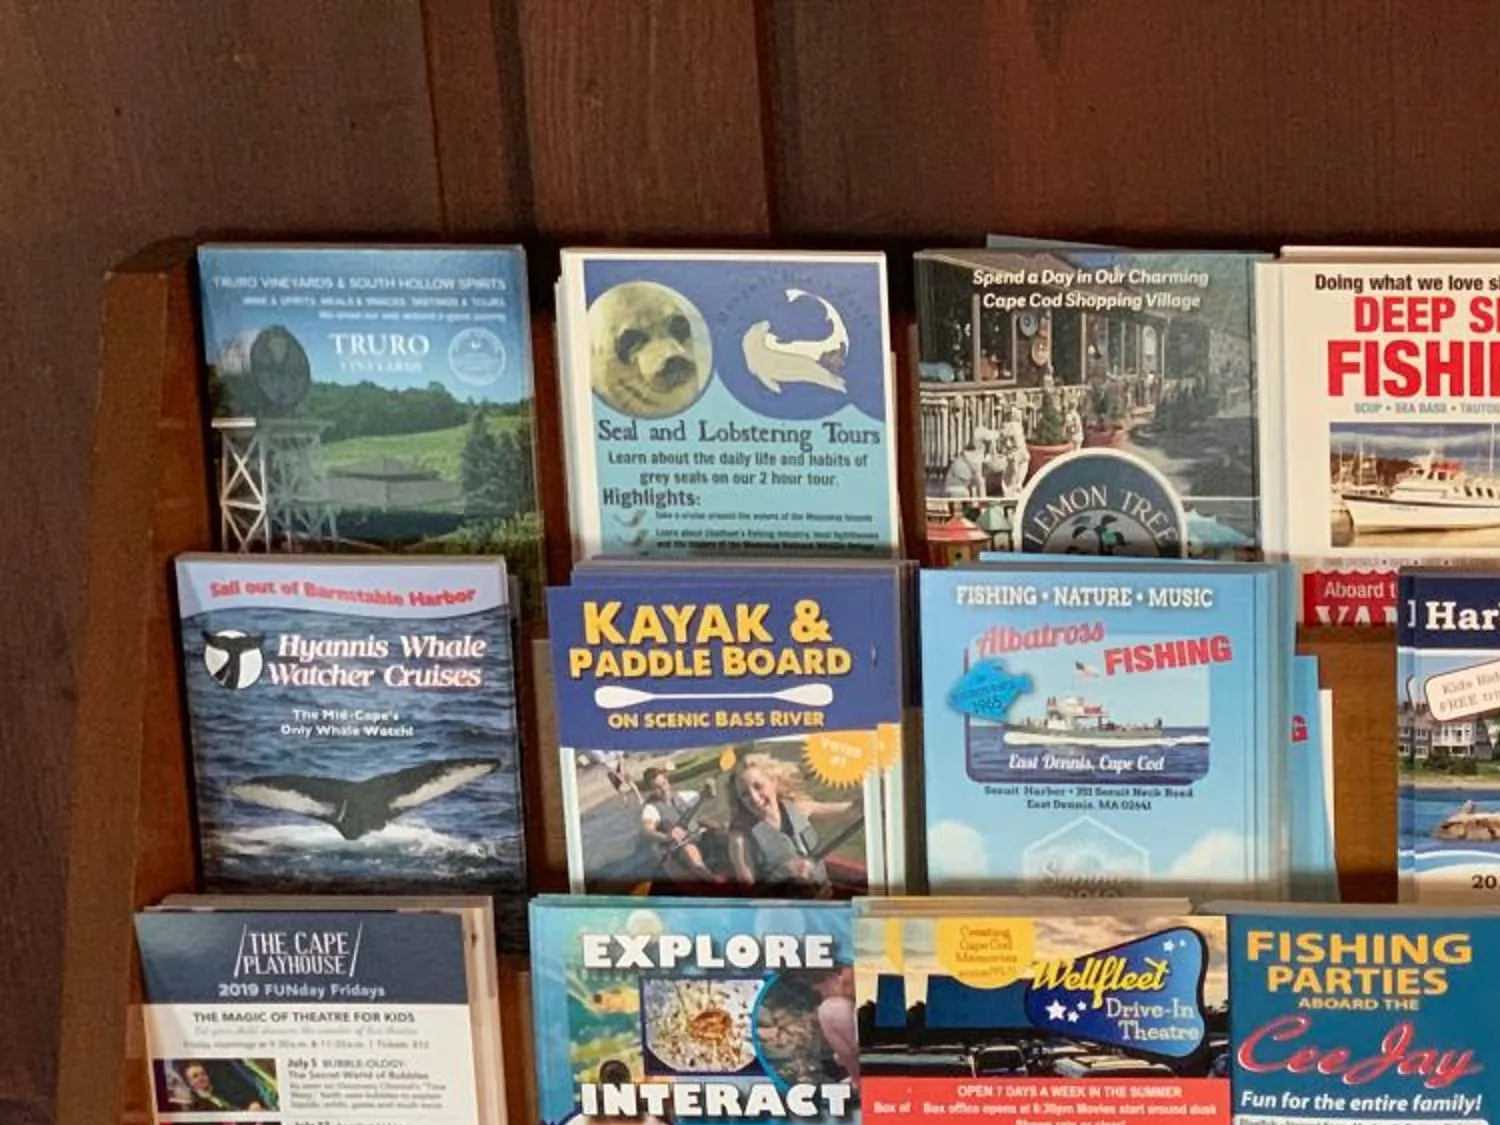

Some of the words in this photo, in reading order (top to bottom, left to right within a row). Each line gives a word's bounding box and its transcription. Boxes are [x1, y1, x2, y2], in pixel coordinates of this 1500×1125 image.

[1314, 275, 1364, 294] Doing
[1368, 275, 1412, 292] what
[1415, 278, 1442, 292] we
[1446, 275, 1484, 292] love
[983, 292, 1024, 311] Cape
[1027, 292, 1058, 309] Cod
[1062, 292, 1138, 312] Shopping
[1142, 291, 1201, 312] Village
[1354, 297, 1455, 333] DEEP
[329, 333, 430, 358] TRURO
[598, 420, 638, 443] Seal
[648, 422, 686, 443] and
[698, 420, 811, 452] Lobstering
[822, 423, 881, 445] Tours
[602, 488, 700, 509] Highlights:
[957, 586, 1037, 605] FISHING
[1054, 587, 1132, 607] NATURE
[1149, 588, 1213, 608] MUSIC
[583, 601, 770, 644] KAYAK
[791, 600, 833, 641] &
[278, 634, 388, 661] Hyannis
[402, 634, 486, 659] Whale
[976, 620, 1105, 658] Albatross
[570, 647, 710, 678] PADDLE
[721, 647, 851, 676] BOARD
[1104, 636, 1233, 675] FISHING
[269, 663, 374, 688] Watcher
[386, 664, 481, 687] Cruises
[249, 932, 289, 955] THE
[295, 932, 349, 955] CAPE
[582, 935, 833, 968] EXPLORE
[1247, 932, 1472, 965] FISHING
[243, 956, 346, 977] PLAYHOUSE
[1031, 956, 1170, 1008] Wellfleet
[1267, 967, 1449, 996] PARTIES
[1106, 999, 1194, 1020] Drive-In
[1118, 1020, 1199, 1042] Theatre
[581, 1084, 851, 1116] INTERACT
[1241, 1090, 1279, 1110] Fun
[1283, 1091, 1312, 1110] for
[1316, 1093, 1342, 1111] the
[1347, 1094, 1399, 1111] entire
[1405, 1093, 1482, 1115] family!
